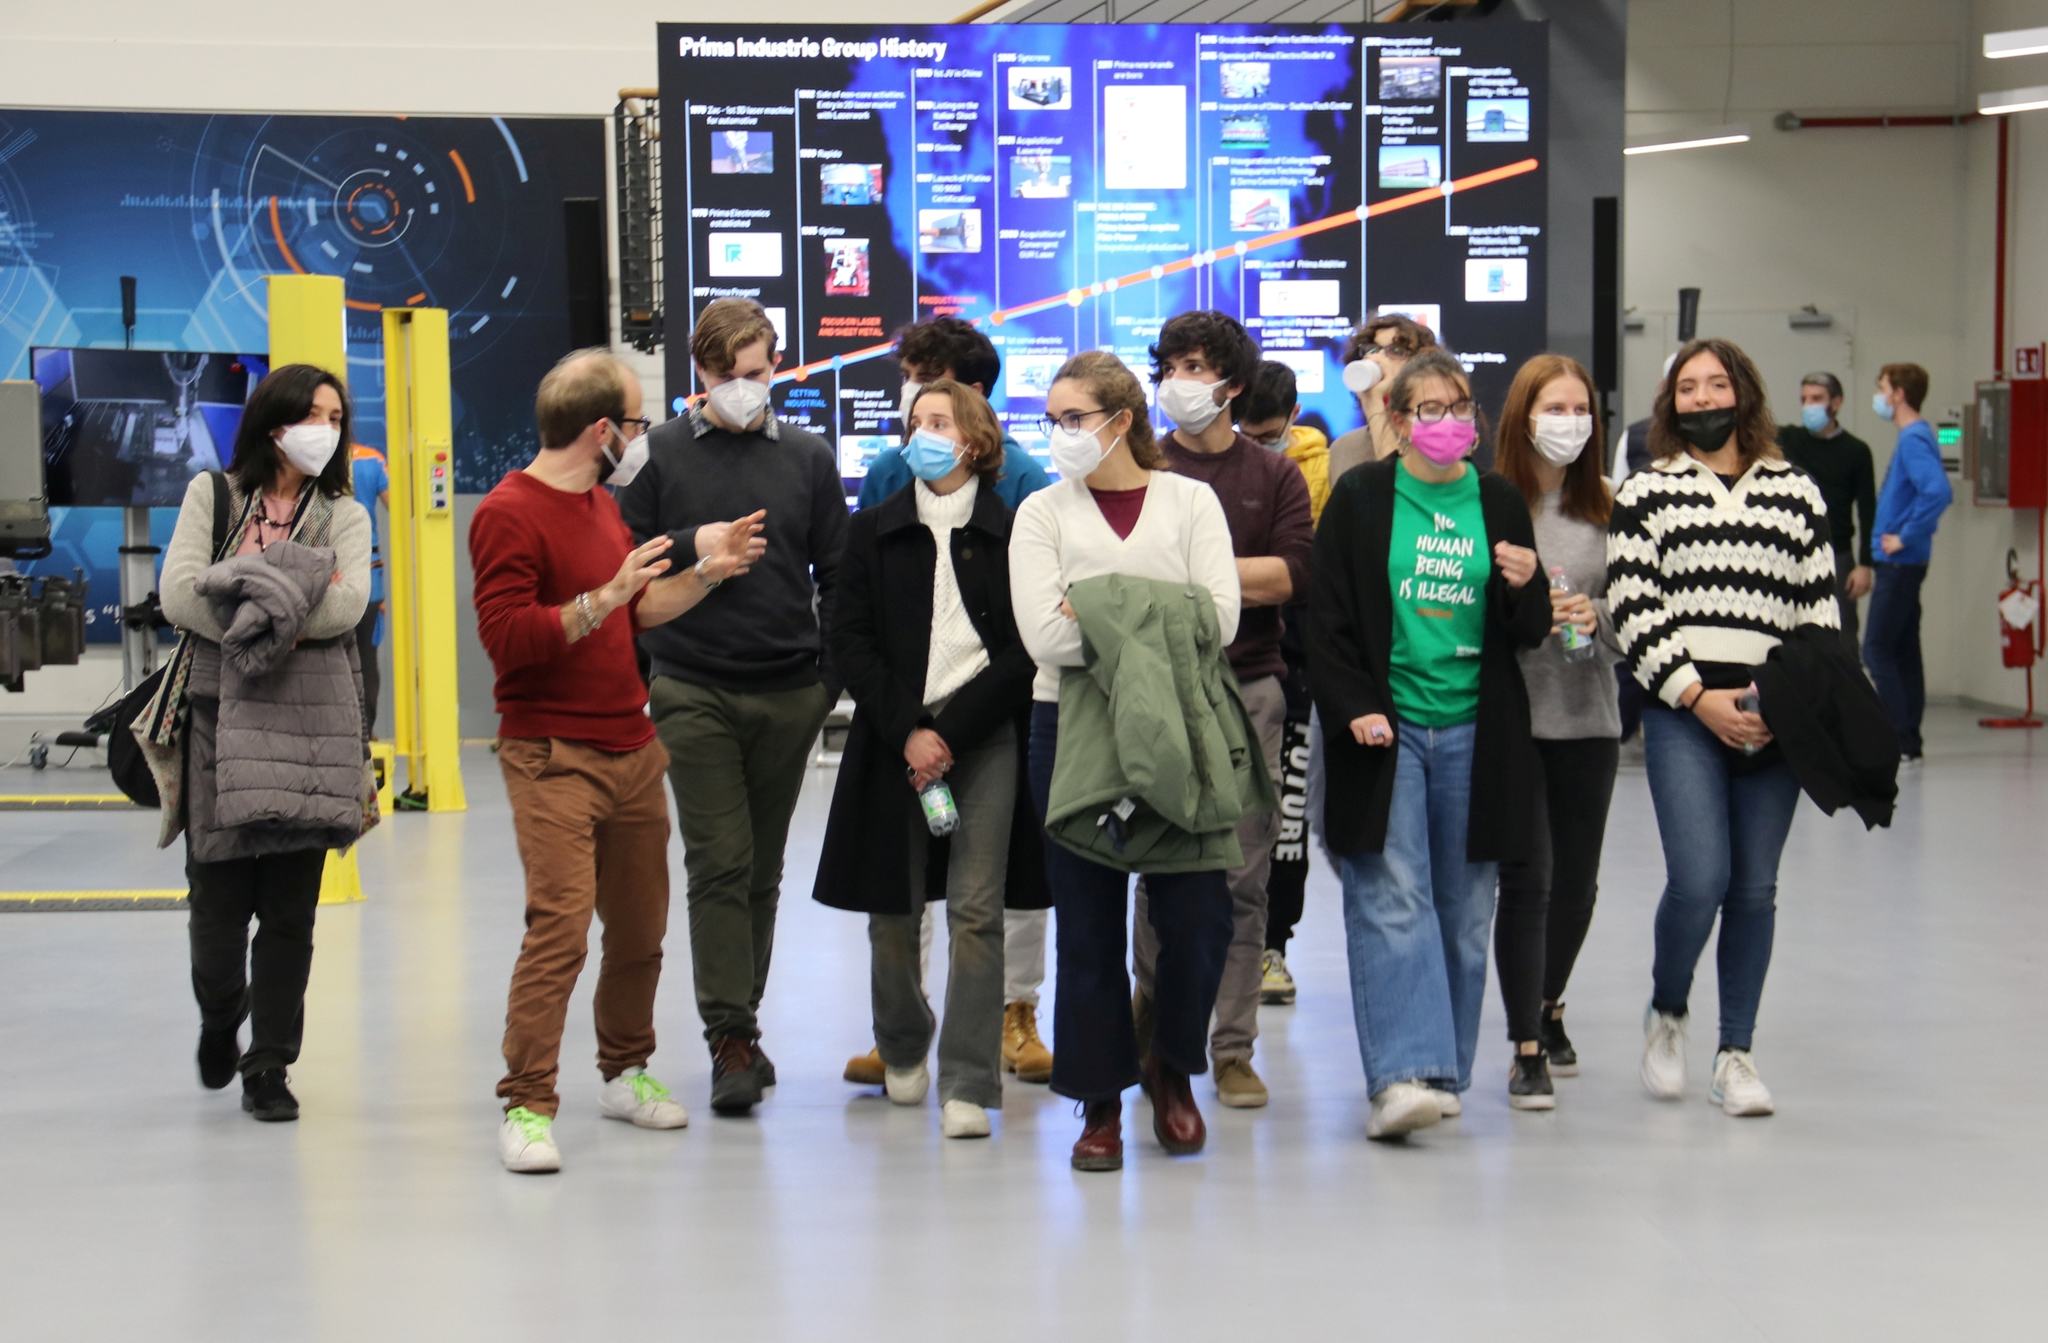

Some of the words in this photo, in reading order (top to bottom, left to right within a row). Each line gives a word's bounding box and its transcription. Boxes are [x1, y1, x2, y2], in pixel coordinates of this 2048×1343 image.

[679, 37, 736, 57] Prima
[736, 37, 820, 57] Industrie
[822, 37, 878, 61] Group
[879, 37, 947, 62] History
[709, 208, 730, 218] Prima
[730, 208, 771, 218] Electronics
[710, 219, 751, 228] established
[856, 317, 881, 326] LASER
[788, 389, 820, 398] GETTING
[878, 400, 892, 408] and
[854, 420, 878, 430] patent
[1416, 534, 1474, 558] HUMAN
[1415, 554, 1464, 581] BEING
[1399, 578, 1413, 600] IS
[1416, 581, 1476, 605] ILLEGAL
